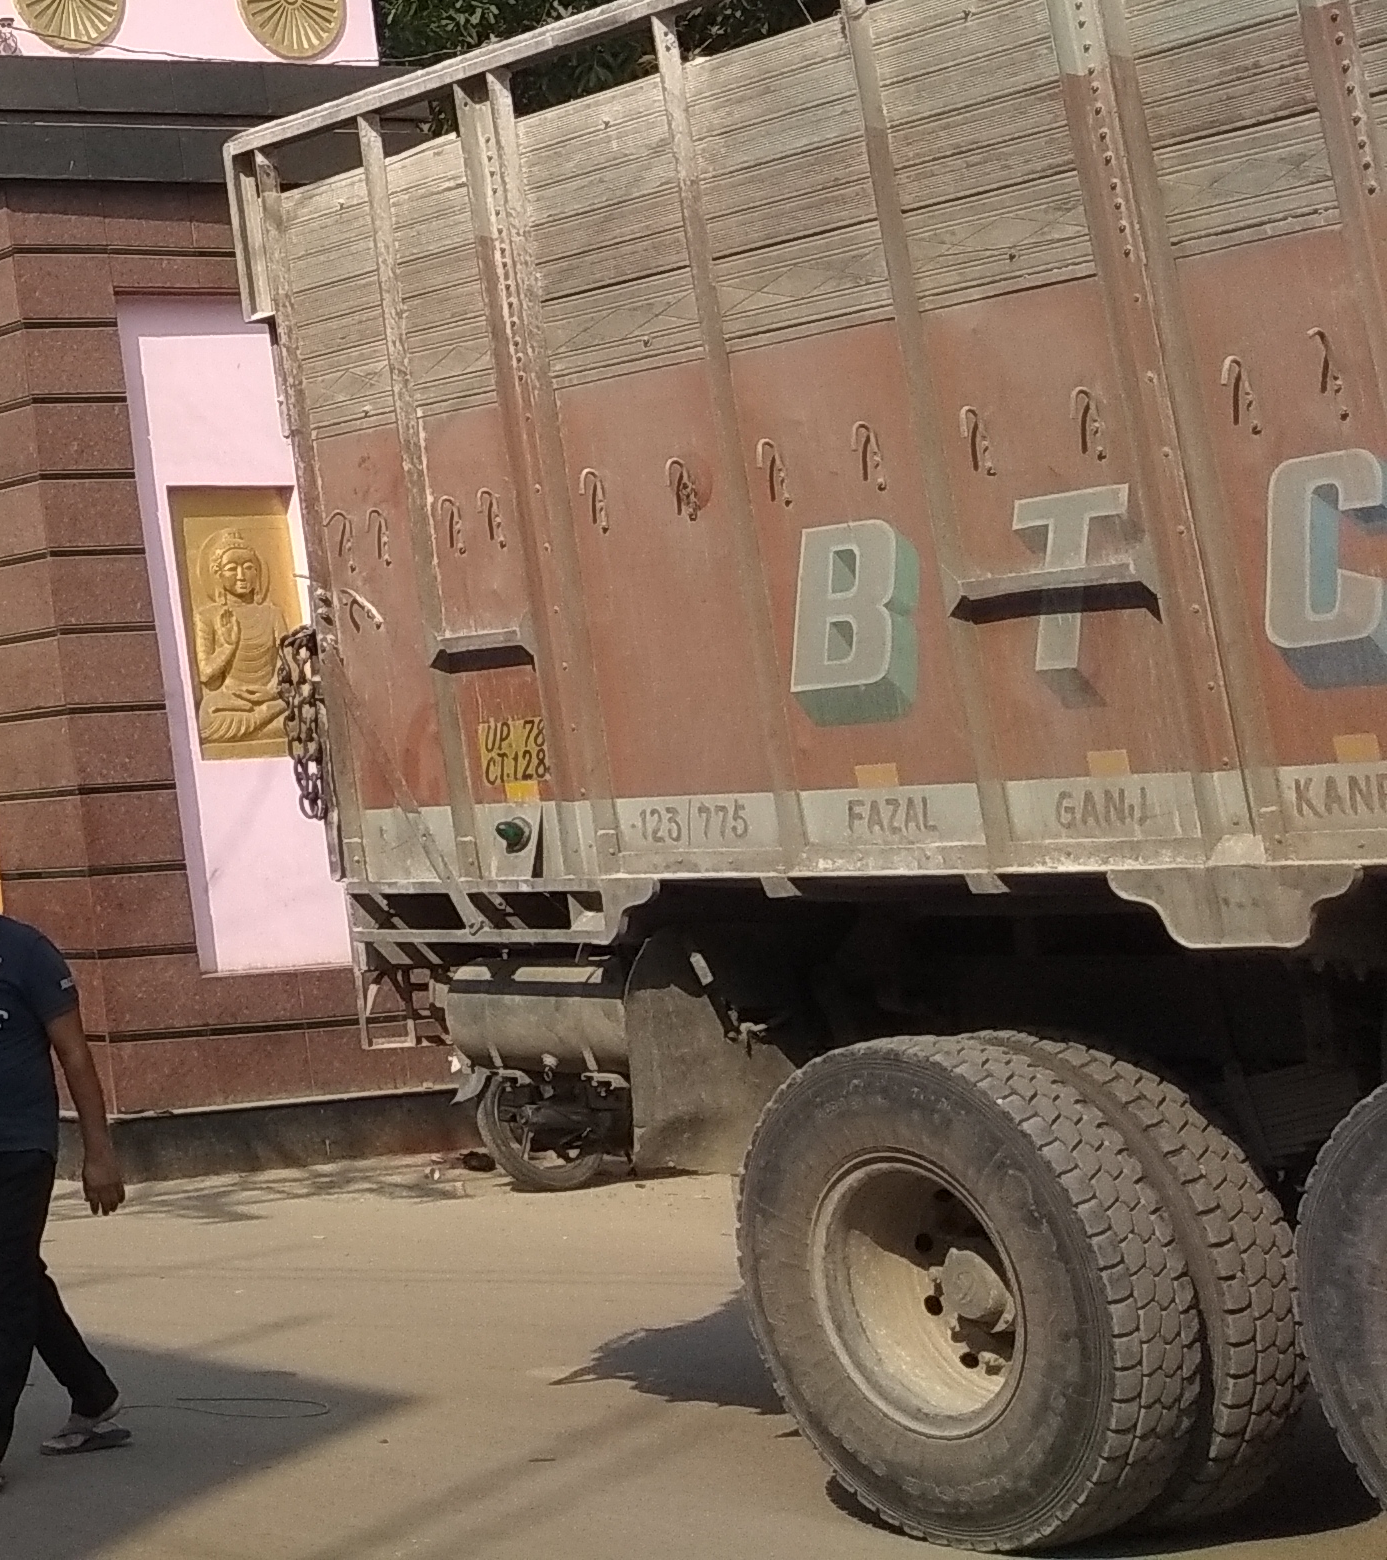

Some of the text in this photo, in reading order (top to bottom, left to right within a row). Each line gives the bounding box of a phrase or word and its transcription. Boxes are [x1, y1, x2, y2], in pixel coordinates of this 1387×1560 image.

[485, 719, 545, 753] UP 78
[848, 795, 938, 835] FAZAL
